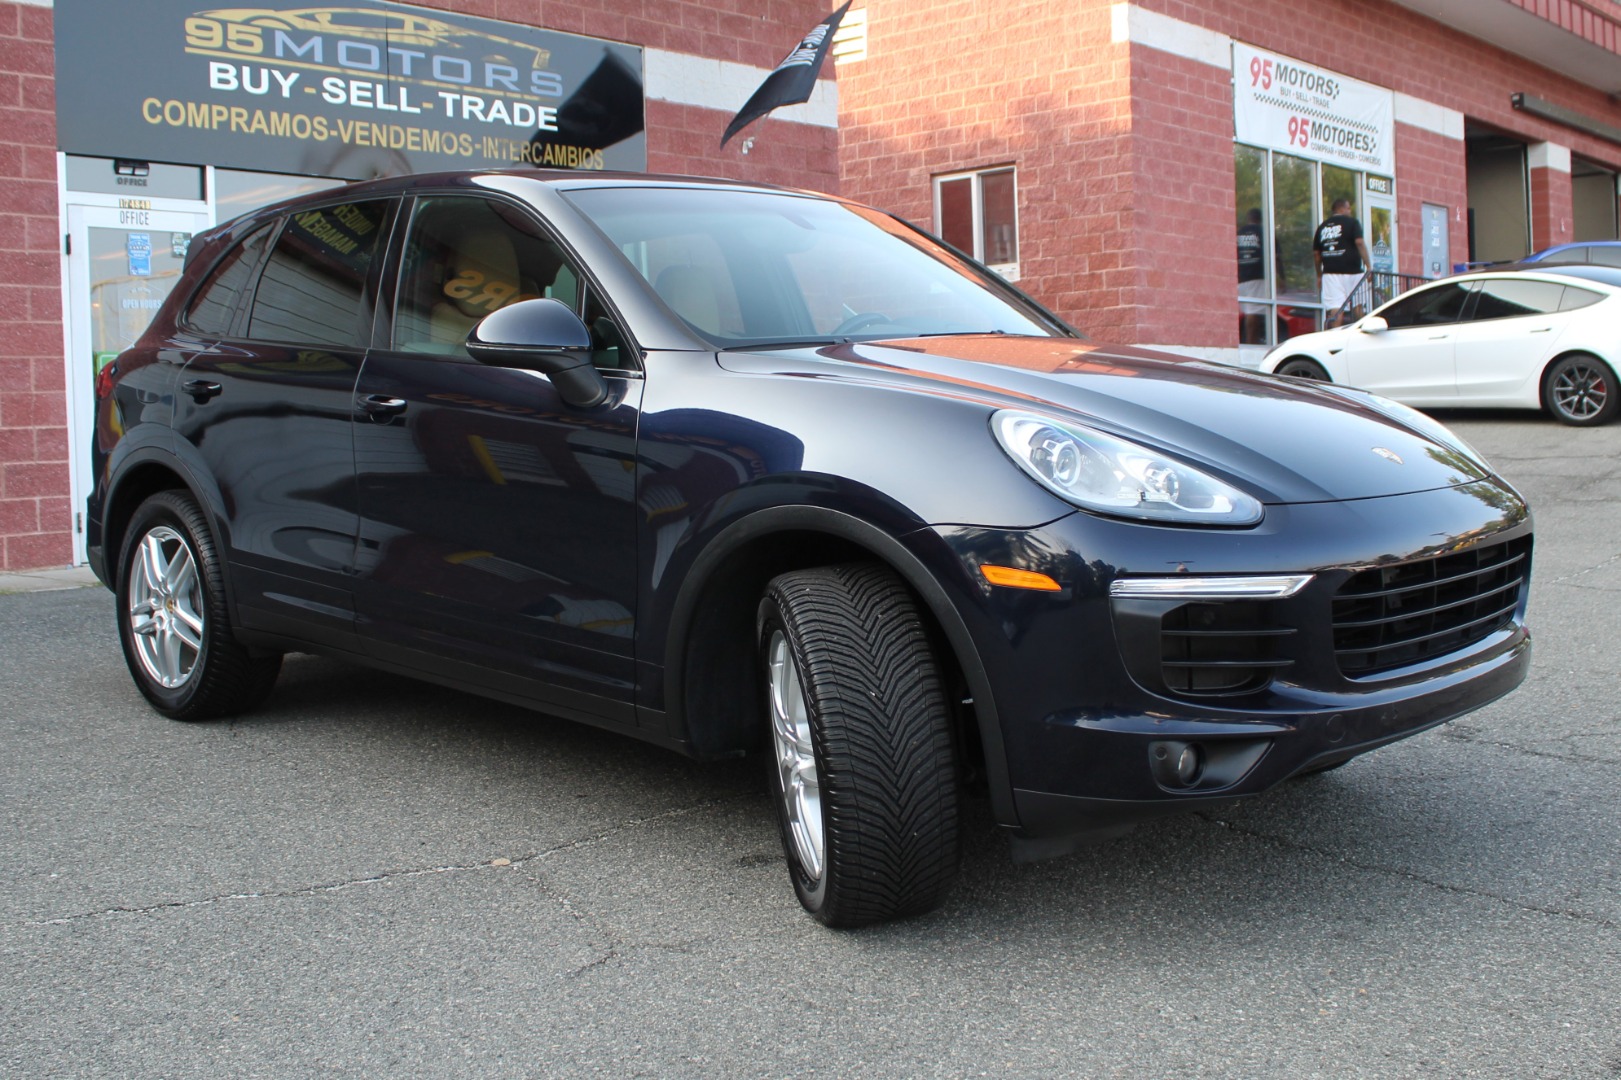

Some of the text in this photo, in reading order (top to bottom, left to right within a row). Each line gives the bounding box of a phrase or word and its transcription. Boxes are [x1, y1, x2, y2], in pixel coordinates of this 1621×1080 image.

[184, 16, 563, 97] 95 MOTORS
[1250, 56, 1334, 97] 95 MOTORS
[1280, 87, 1329, 108] BUY SELL TRADE
[1288, 115, 1369, 152] 95 MOTORES
[1311, 142, 1334, 154] COMPRAR
[1337, 150, 1355, 160] VENDER
[116, 177, 148, 187] OFFICE
[1369, 178, 1386, 192] OFFICE
[120, 210, 150, 226] OFFICE
[123, 299, 139, 309] OPEN
